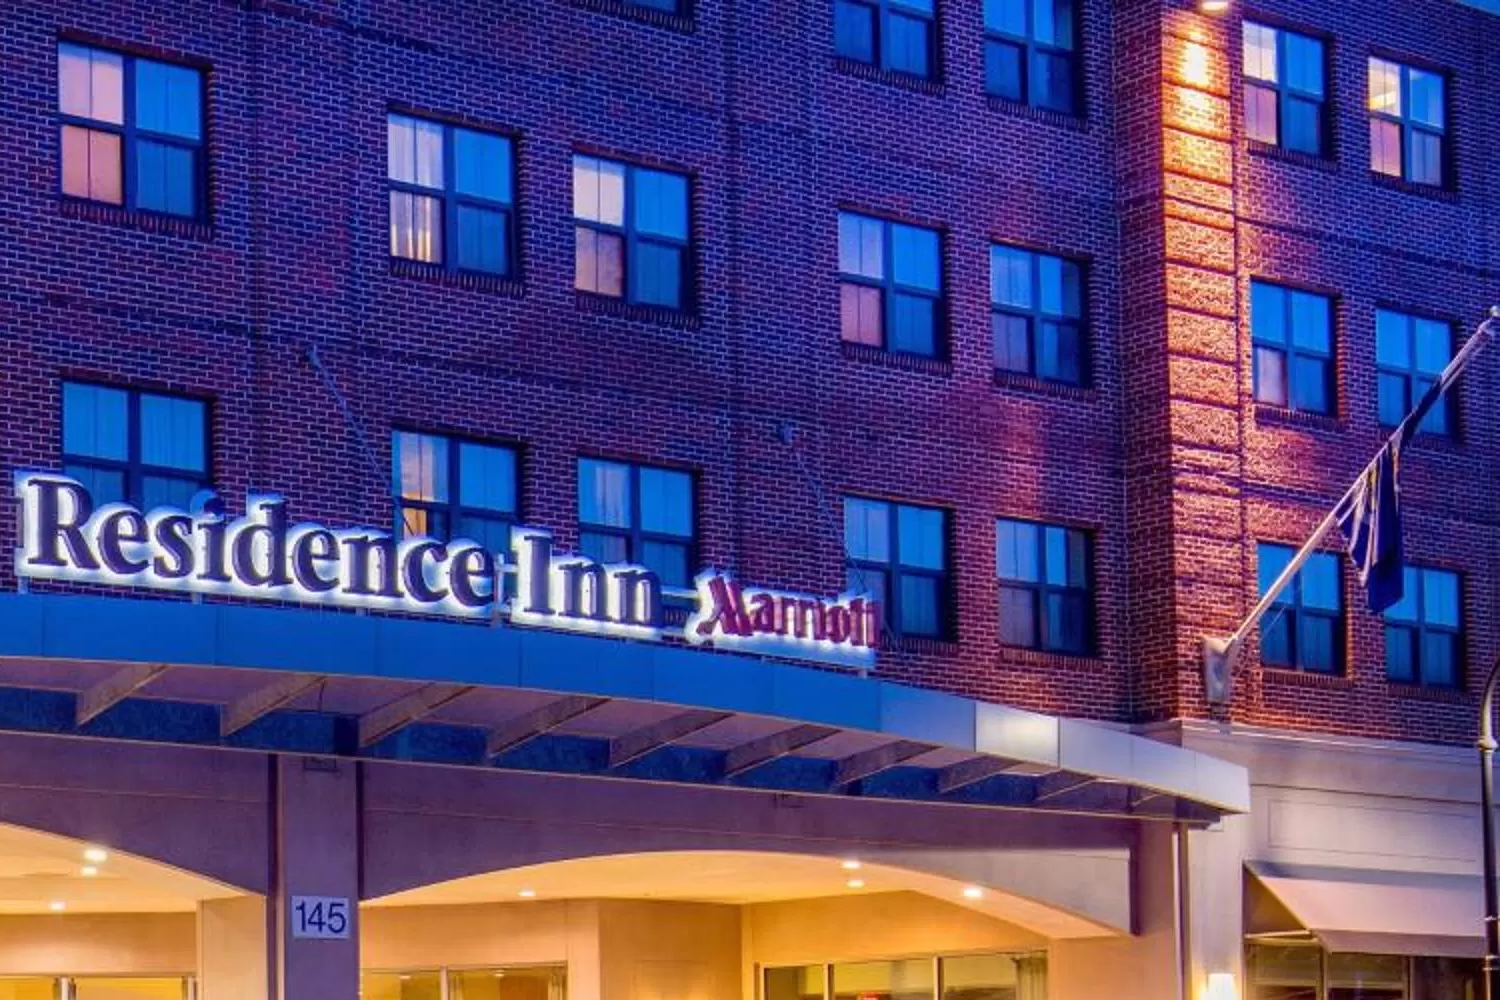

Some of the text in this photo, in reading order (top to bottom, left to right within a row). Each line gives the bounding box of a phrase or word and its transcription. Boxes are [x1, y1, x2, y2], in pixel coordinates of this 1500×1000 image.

[27, 477, 881, 648] Residence Inn Marriott
[295, 901, 346, 934] 145
